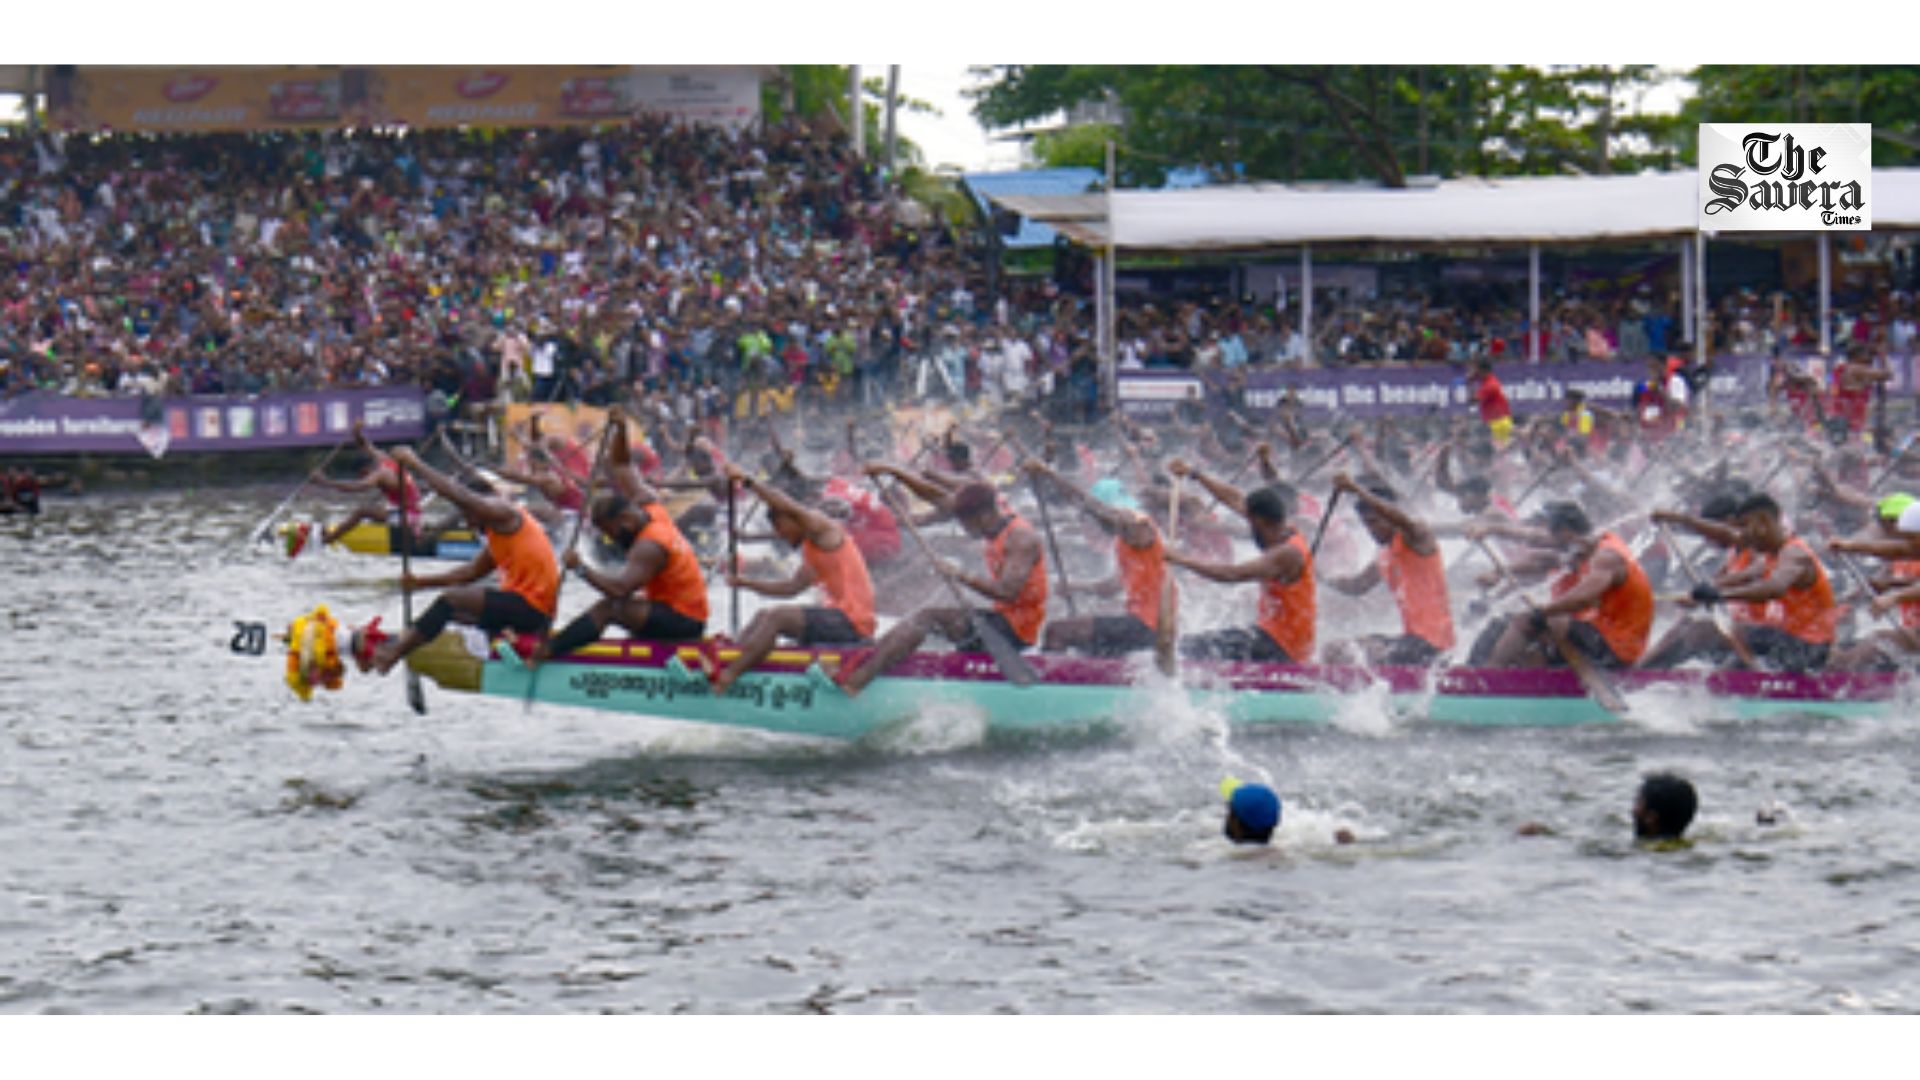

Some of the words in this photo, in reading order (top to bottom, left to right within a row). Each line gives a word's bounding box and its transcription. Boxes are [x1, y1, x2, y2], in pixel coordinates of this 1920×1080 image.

[1344, 382, 1377, 404] the
[1379, 381, 1450, 408] beauty
[230, 620, 267, 657] 20
